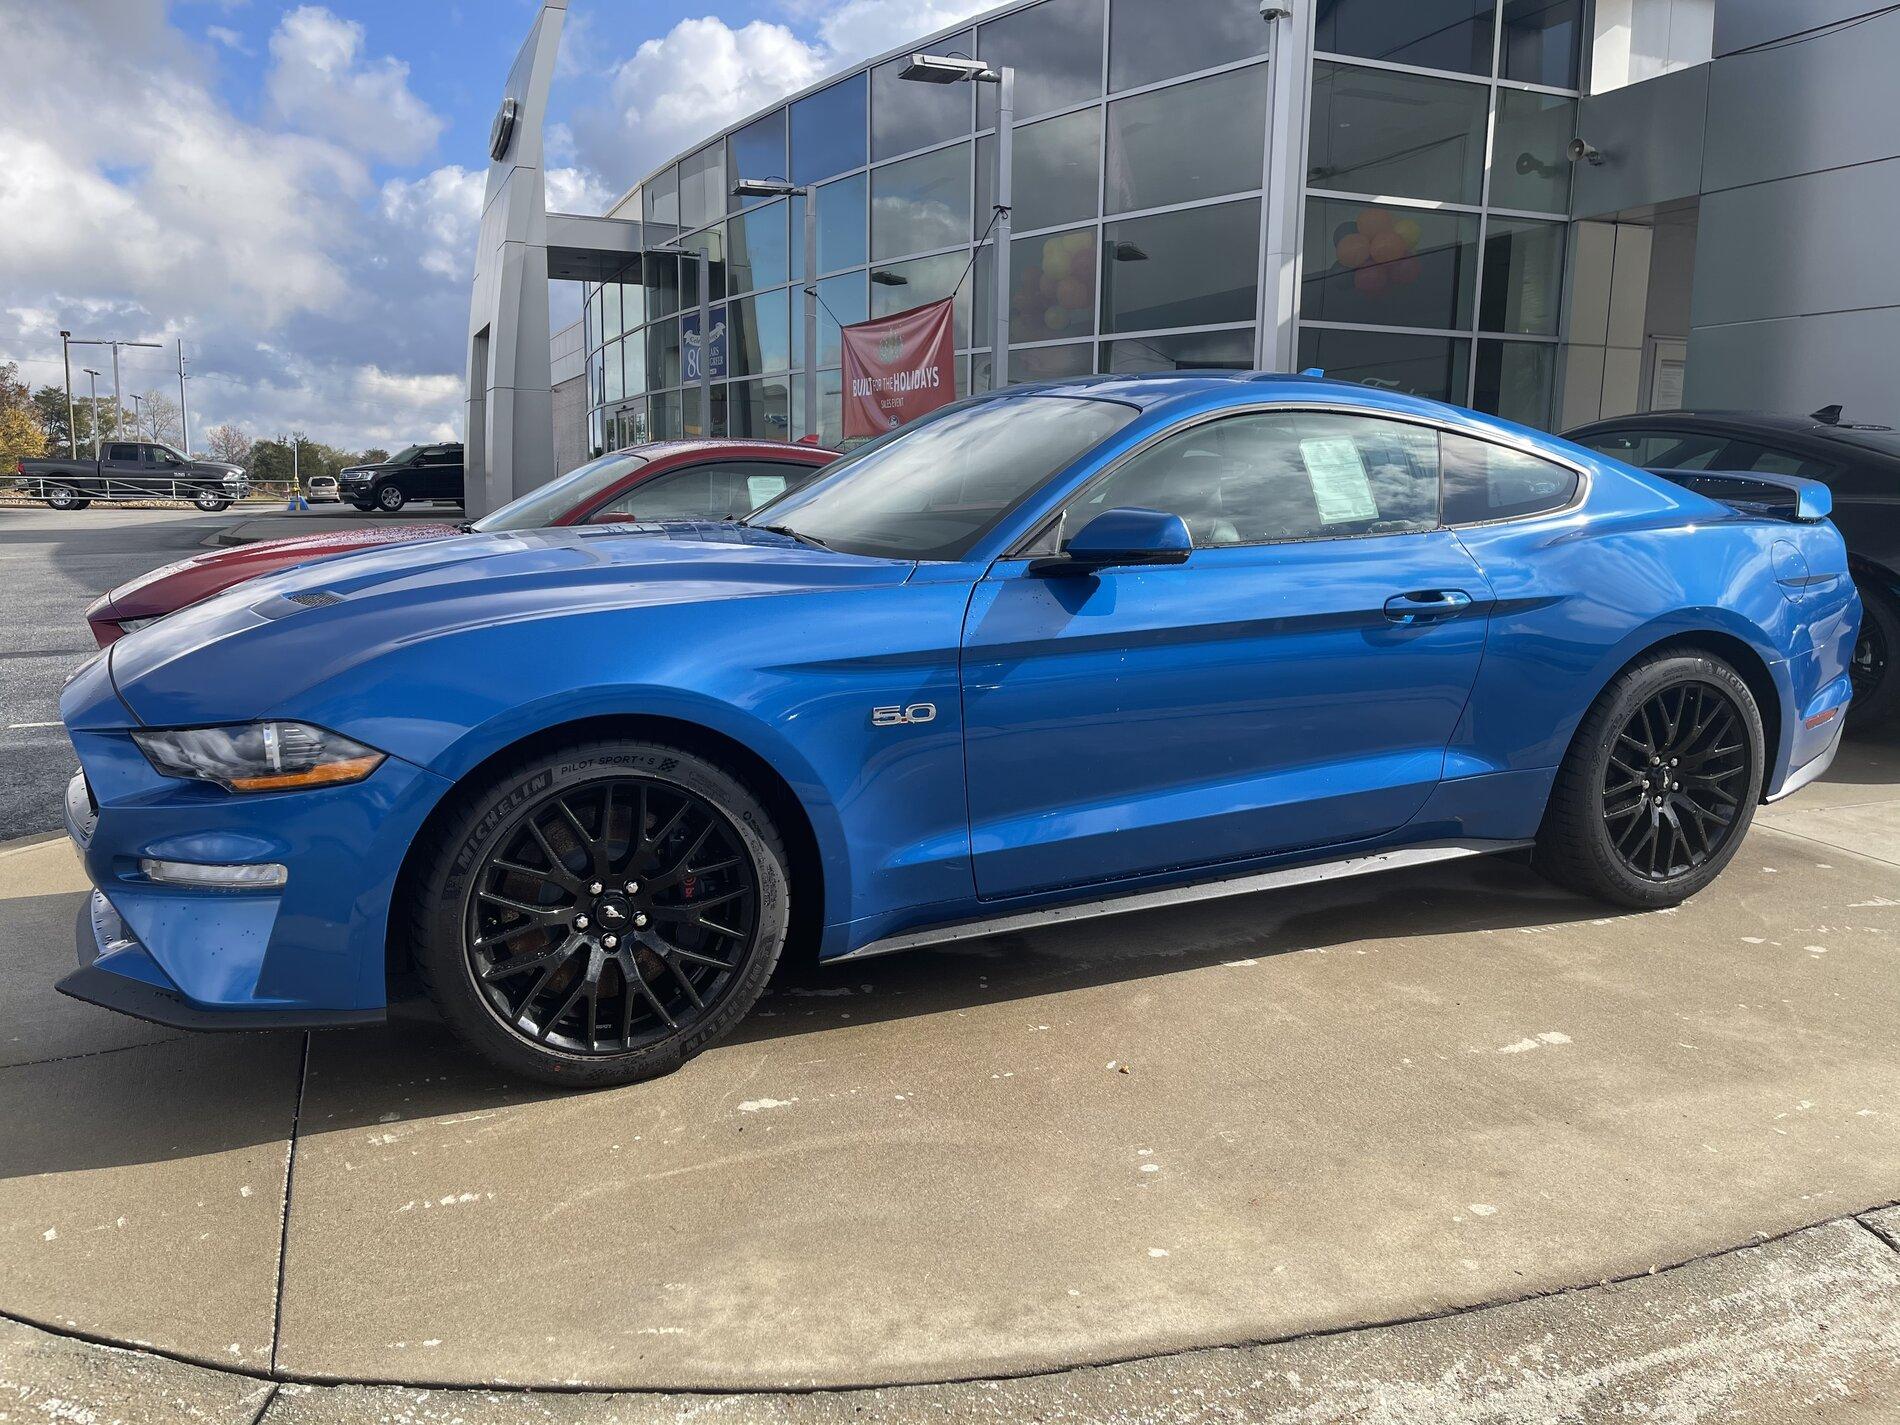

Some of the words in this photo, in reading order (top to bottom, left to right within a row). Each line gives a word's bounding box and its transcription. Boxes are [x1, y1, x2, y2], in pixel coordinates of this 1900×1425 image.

[853, 377, 873, 397] BUILT
[873, 379, 881, 391] FOR
[883, 377, 893, 391] THE
[893, 366, 940, 392] HOLIDAYS
[892, 398, 904, 407] EVENT
[871, 702, 937, 726] 5.0
[561, 758, 593, 775] PILOT
[599, 755, 638, 765] SPORT
[647, 757, 655, 765] S
[458, 773, 548, 870] MICHELIN
